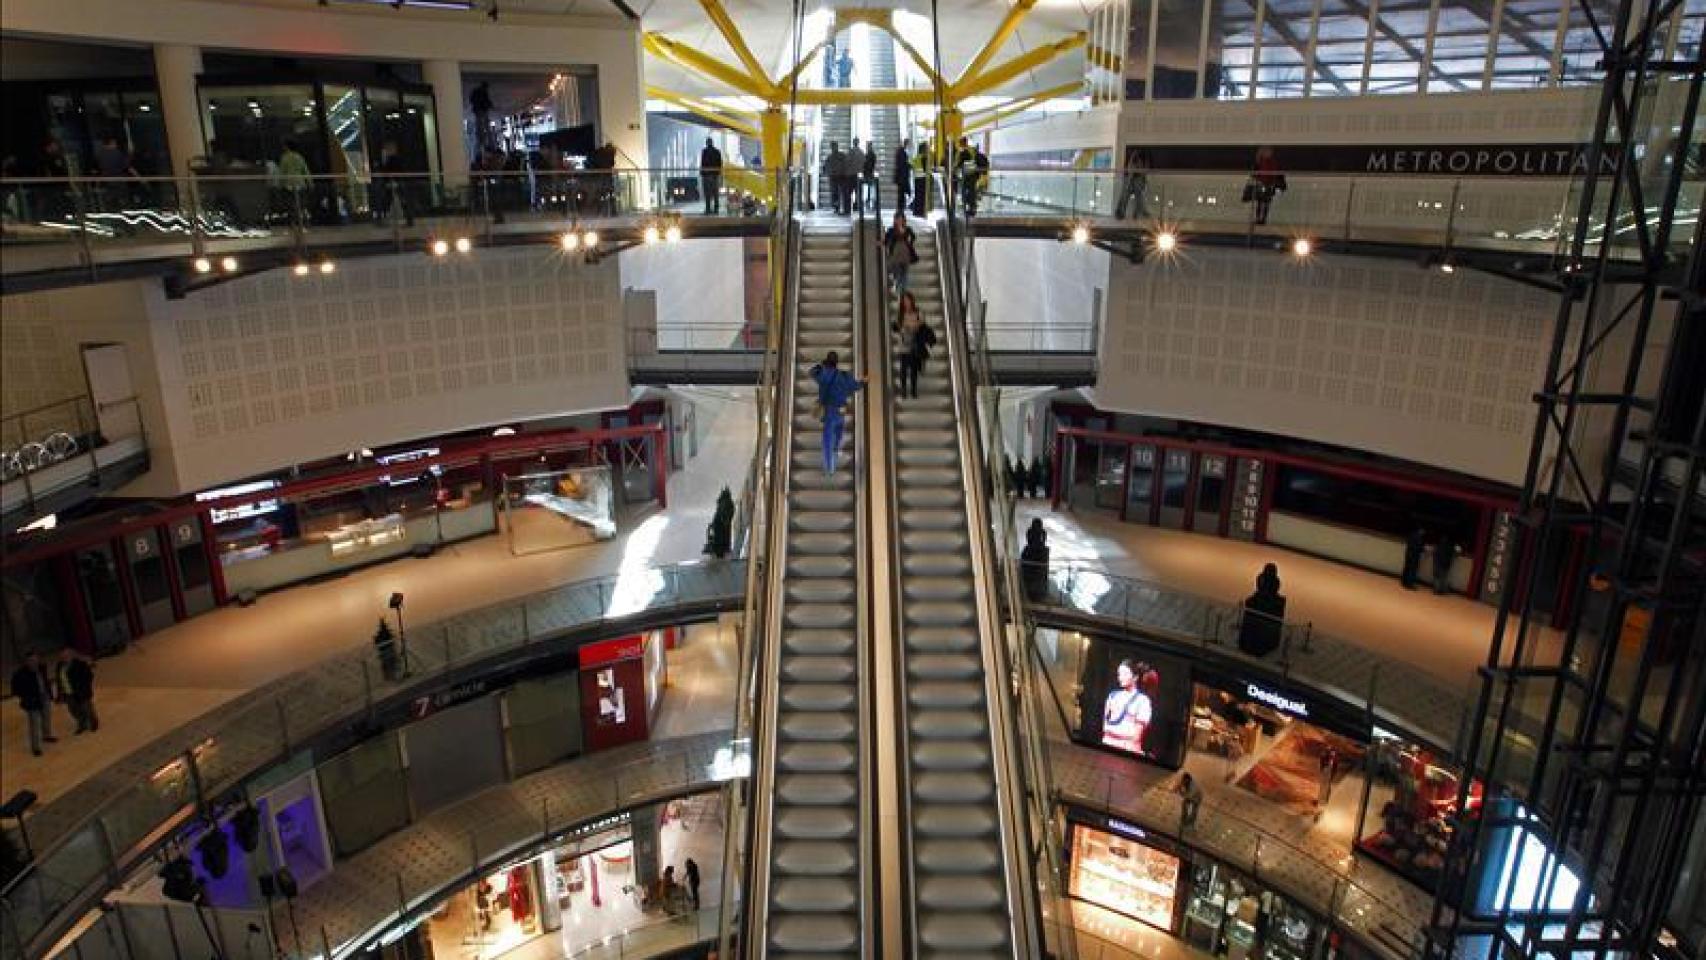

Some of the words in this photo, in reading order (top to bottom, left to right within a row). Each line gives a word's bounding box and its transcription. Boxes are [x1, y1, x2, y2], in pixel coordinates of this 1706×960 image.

[1366, 149, 1619, 173] METROPOLITAN
[1134, 450, 1153, 464] 10
[178, 524, 192, 541] 9
[136, 538, 149, 555] 8
[415, 696, 430, 718] 7
